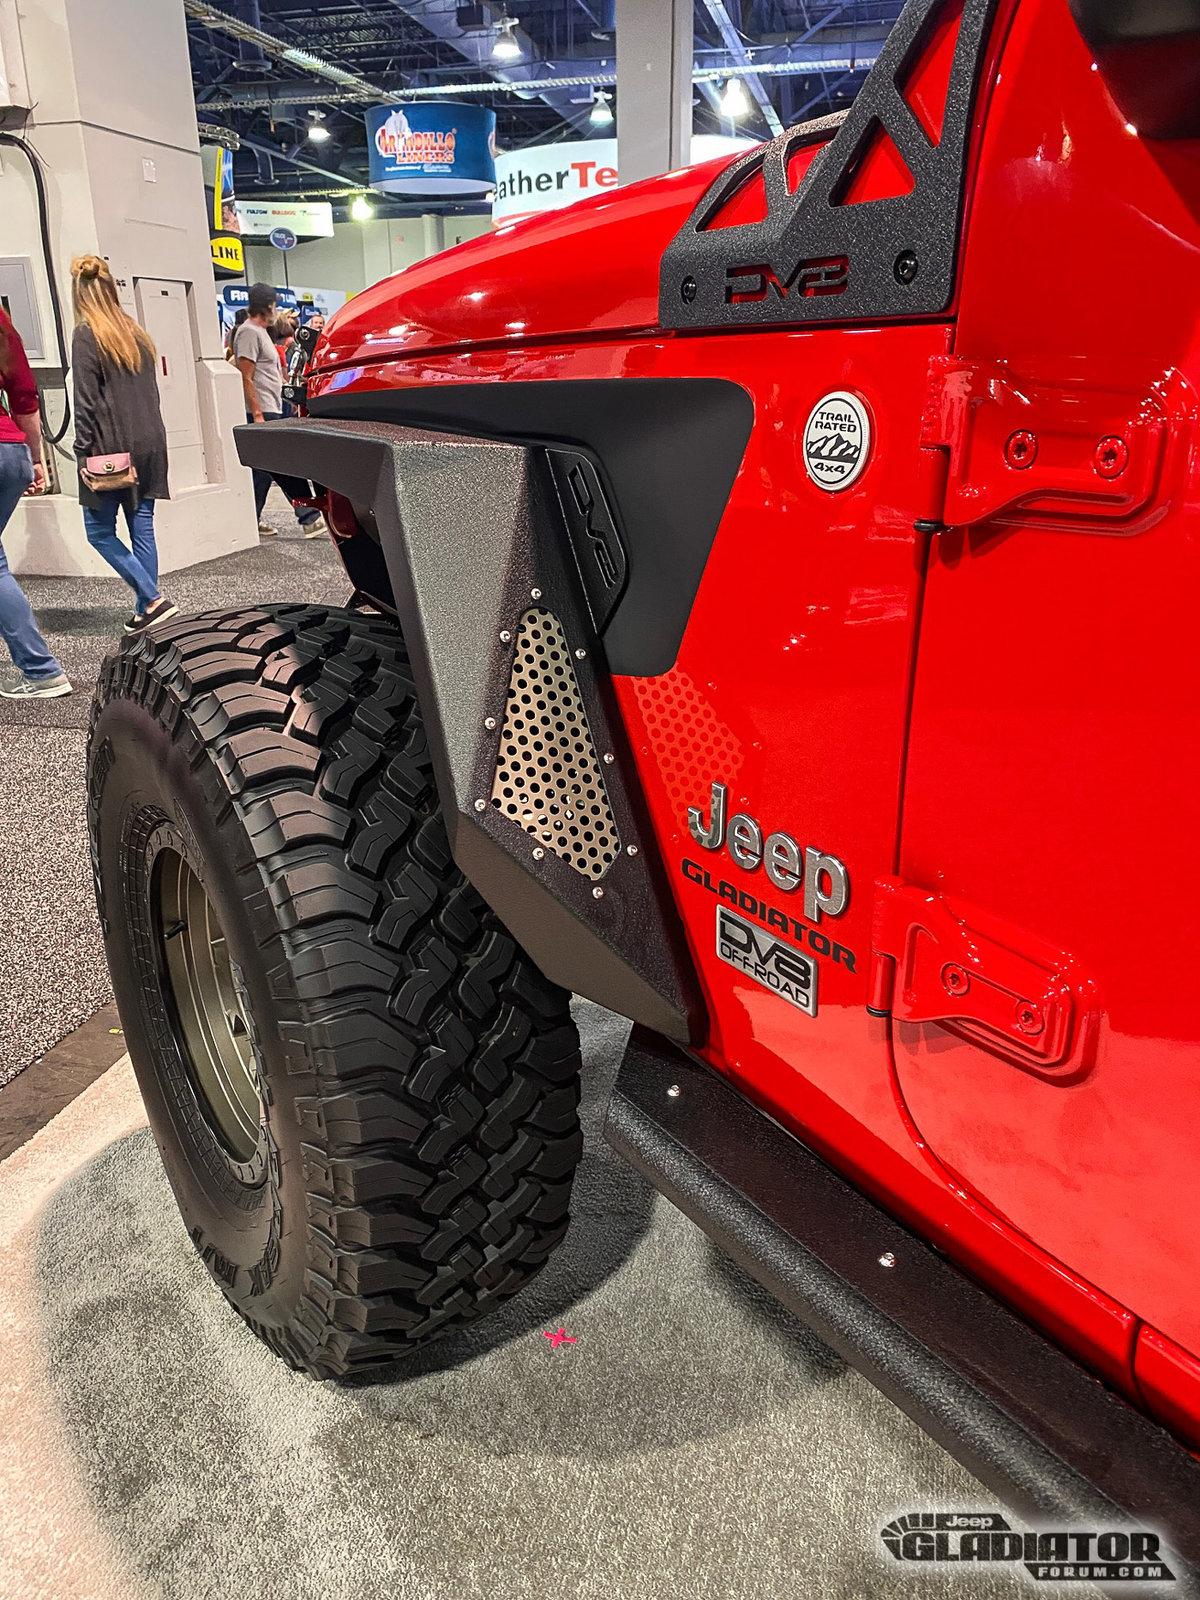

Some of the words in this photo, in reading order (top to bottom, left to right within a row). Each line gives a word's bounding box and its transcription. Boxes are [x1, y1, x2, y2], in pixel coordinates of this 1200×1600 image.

[397, 152, 455, 163] LINERS
[819, 411, 855, 423] TRAIL
[815, 421, 857, 433] RATED
[813, 462, 846, 475] 4x4
[687, 781, 850, 923] Jeep
[681, 857, 858, 974] GLADIATOR
[719, 912, 812, 990] DV8
